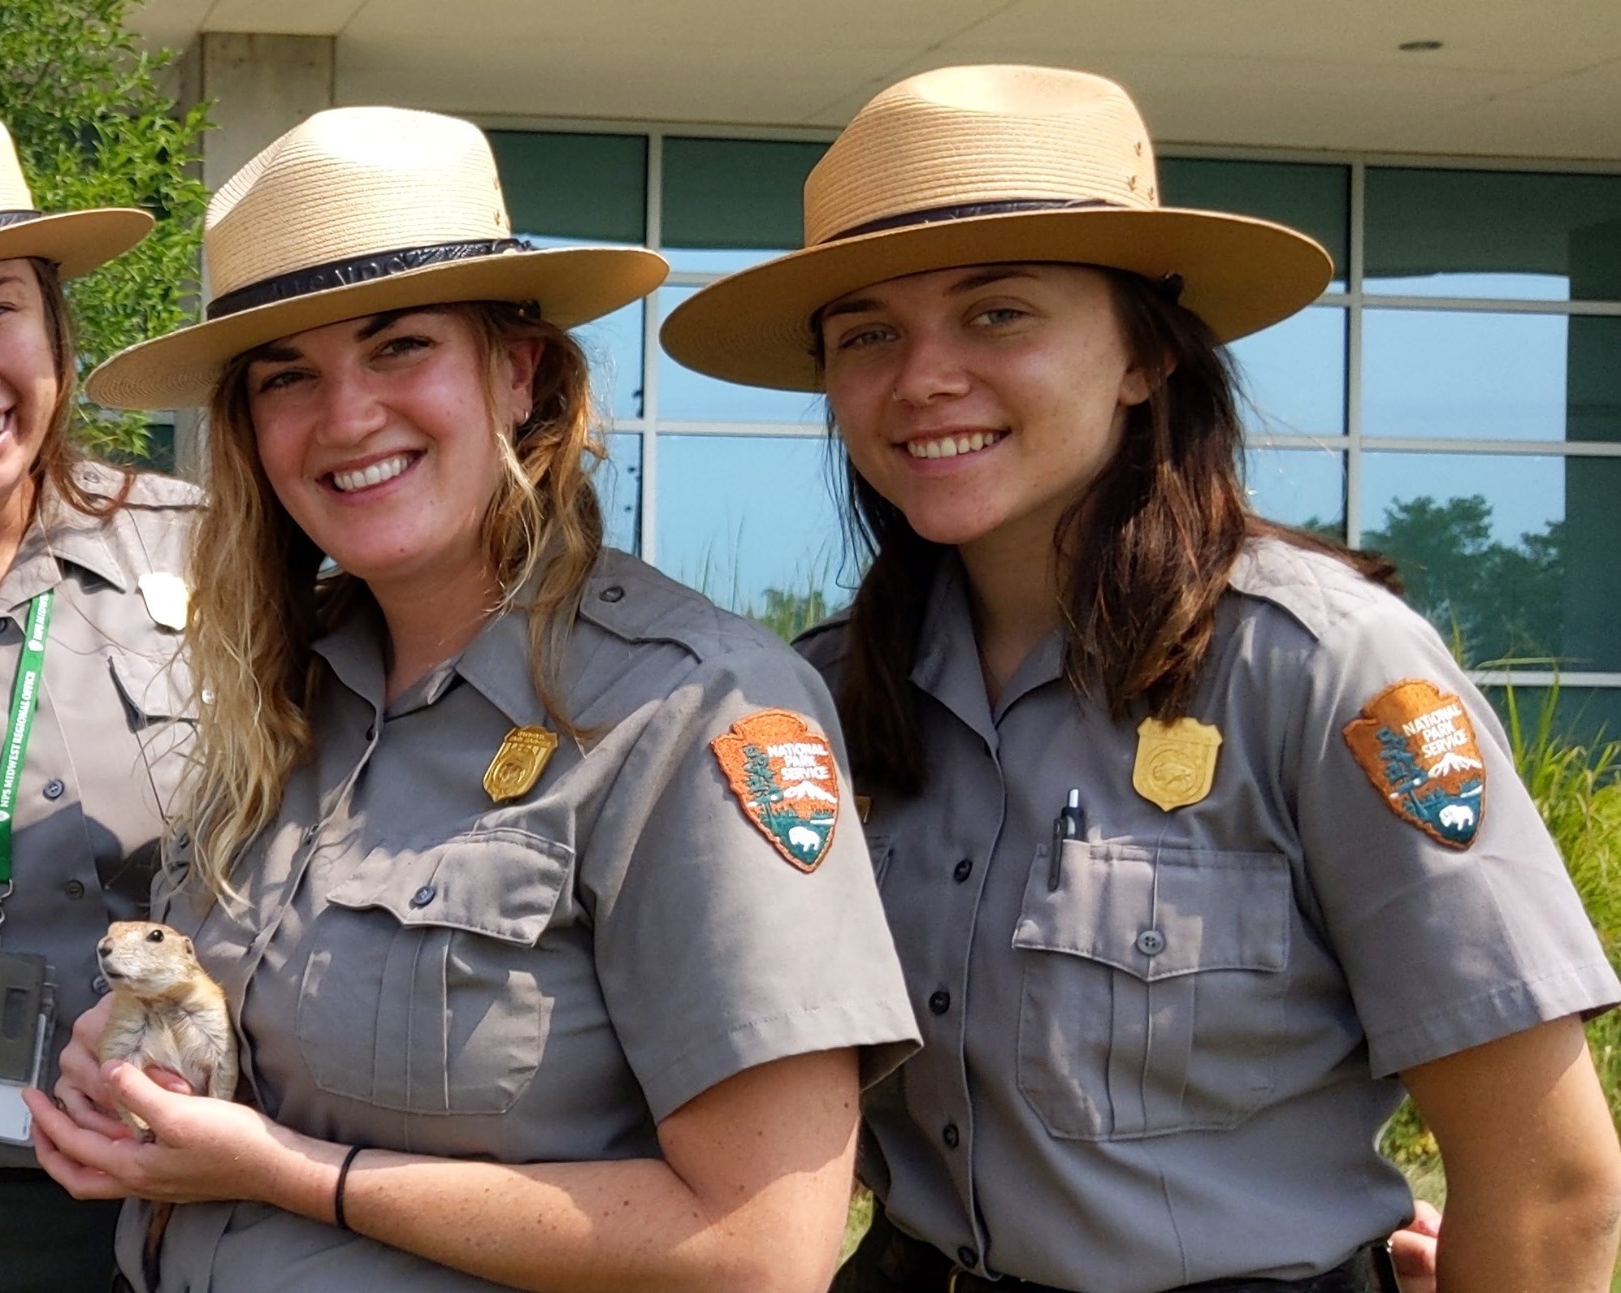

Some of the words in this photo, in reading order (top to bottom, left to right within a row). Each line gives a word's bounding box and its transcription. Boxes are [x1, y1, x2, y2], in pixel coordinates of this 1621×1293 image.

[21, 670, 36, 701] OFFICE
[11, 699, 31, 745] REGIONAL
[1402, 703, 1463, 737] NATIONAL
[1422, 719, 1456, 743] PARK
[767, 743, 829, 757] NATIONAL
[1421, 728, 1469, 759] SERVICE
[3, 744, 21, 789] MIDWEST
[781, 765, 831, 780] SERVICE
[784, 754, 817, 768] PARK
[0, 789, 12, 808] NPS
